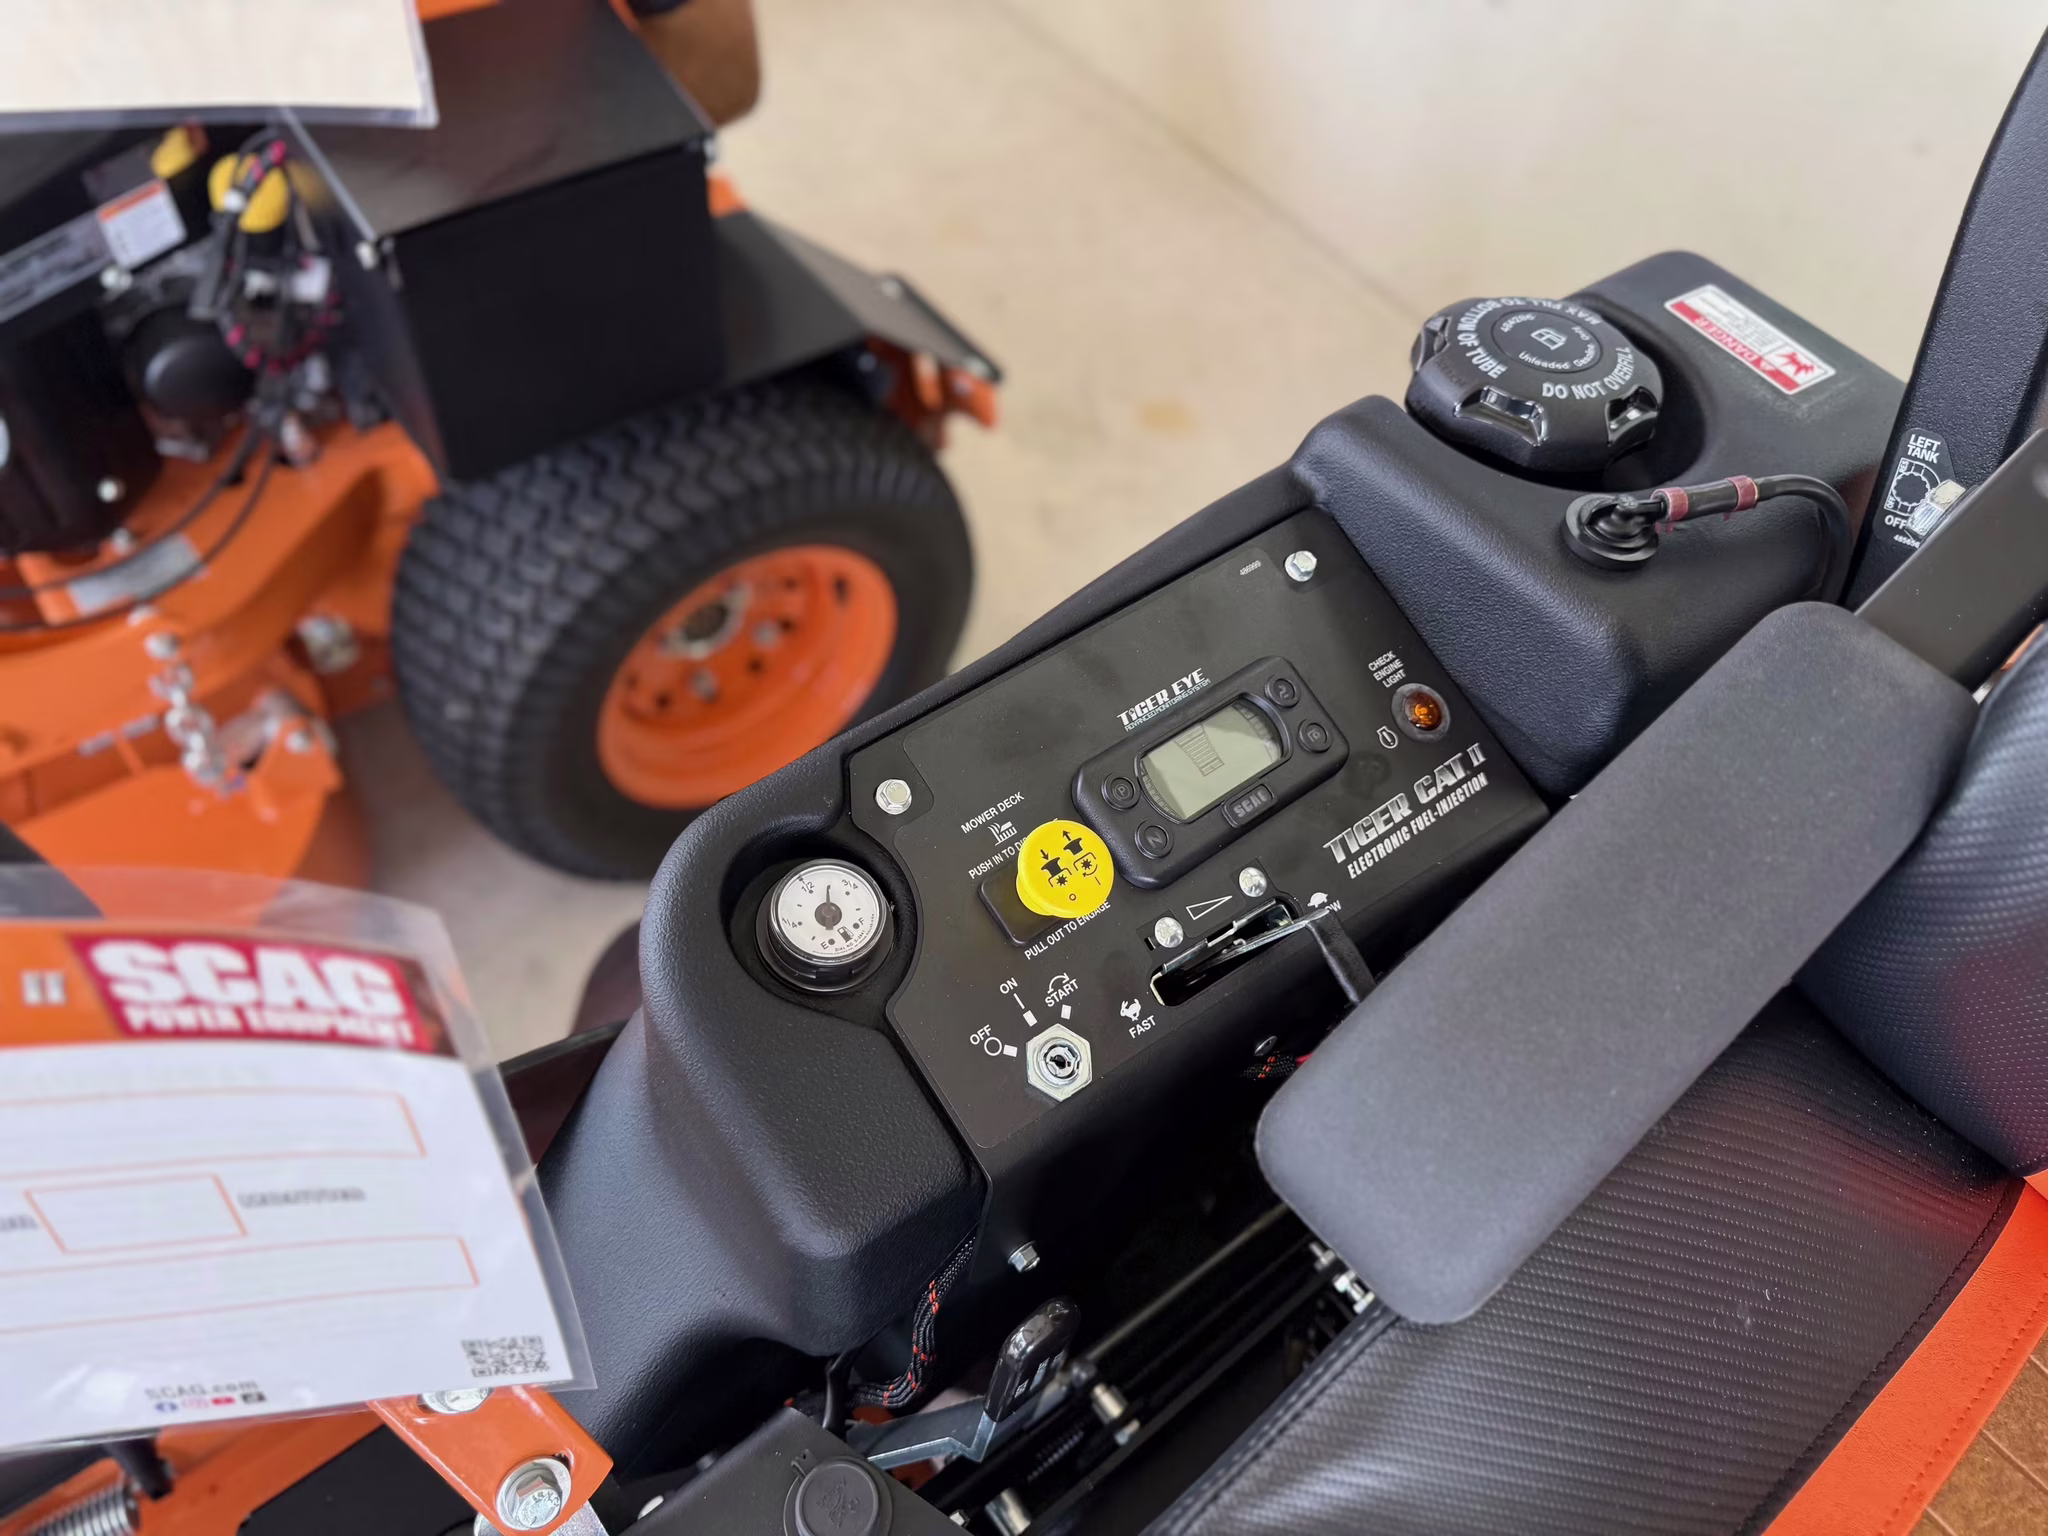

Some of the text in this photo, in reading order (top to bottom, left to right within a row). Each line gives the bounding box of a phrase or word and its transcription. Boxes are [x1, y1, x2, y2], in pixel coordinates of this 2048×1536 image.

[1457, 299, 1502, 332] BOTTOM
[1457, 333, 1478, 349] OF
[1694, 316, 1759, 362] DANGER
[1465, 349, 1509, 379] TUBE
[1518, 351, 1571, 370] Unleaded
[1541, 346, 1636, 400] DO NOT OVERFILL
[1907, 444, 1940, 464] TANK
[1909, 434, 1941, 451] LEFT
[1886, 496, 1896, 509] OFF
[1884, 515, 1907, 530] OFF
[1368, 650, 1397, 672] CHECK
[1373, 658, 1404, 682] ENGINE
[1171, 667, 1206, 696] EYE
[1382, 669, 1406, 688] LIGHT
[1124, 707, 1158, 732] ADVANCED
[1188, 677, 1212, 698] SYSTEM
[961, 791, 1025, 834] MOWER DECK
[1323, 742, 1488, 864] TIGER CAT II
[1347, 771, 1489, 880] ELECTRONIC FUEL-INJECTION
[968, 845, 1016, 880] PUSH IN TO
[801, 881, 815, 892] 1/2
[842, 879, 858, 890] 3/4
[858, 917, 865, 926] F
[1024, 901, 1111, 960] PULL OUT TO ENGAGE
[820, 941, 829, 950] E
[90, 939, 407, 1018] SCAG
[1000, 977, 1019, 995] ON
[1044, 978, 1080, 1007] START
[123, 1004, 416, 1044] POWER EQUIPMENT
[970, 1024, 993, 1046] OFF
[1129, 1015, 1156, 1039] FAST
